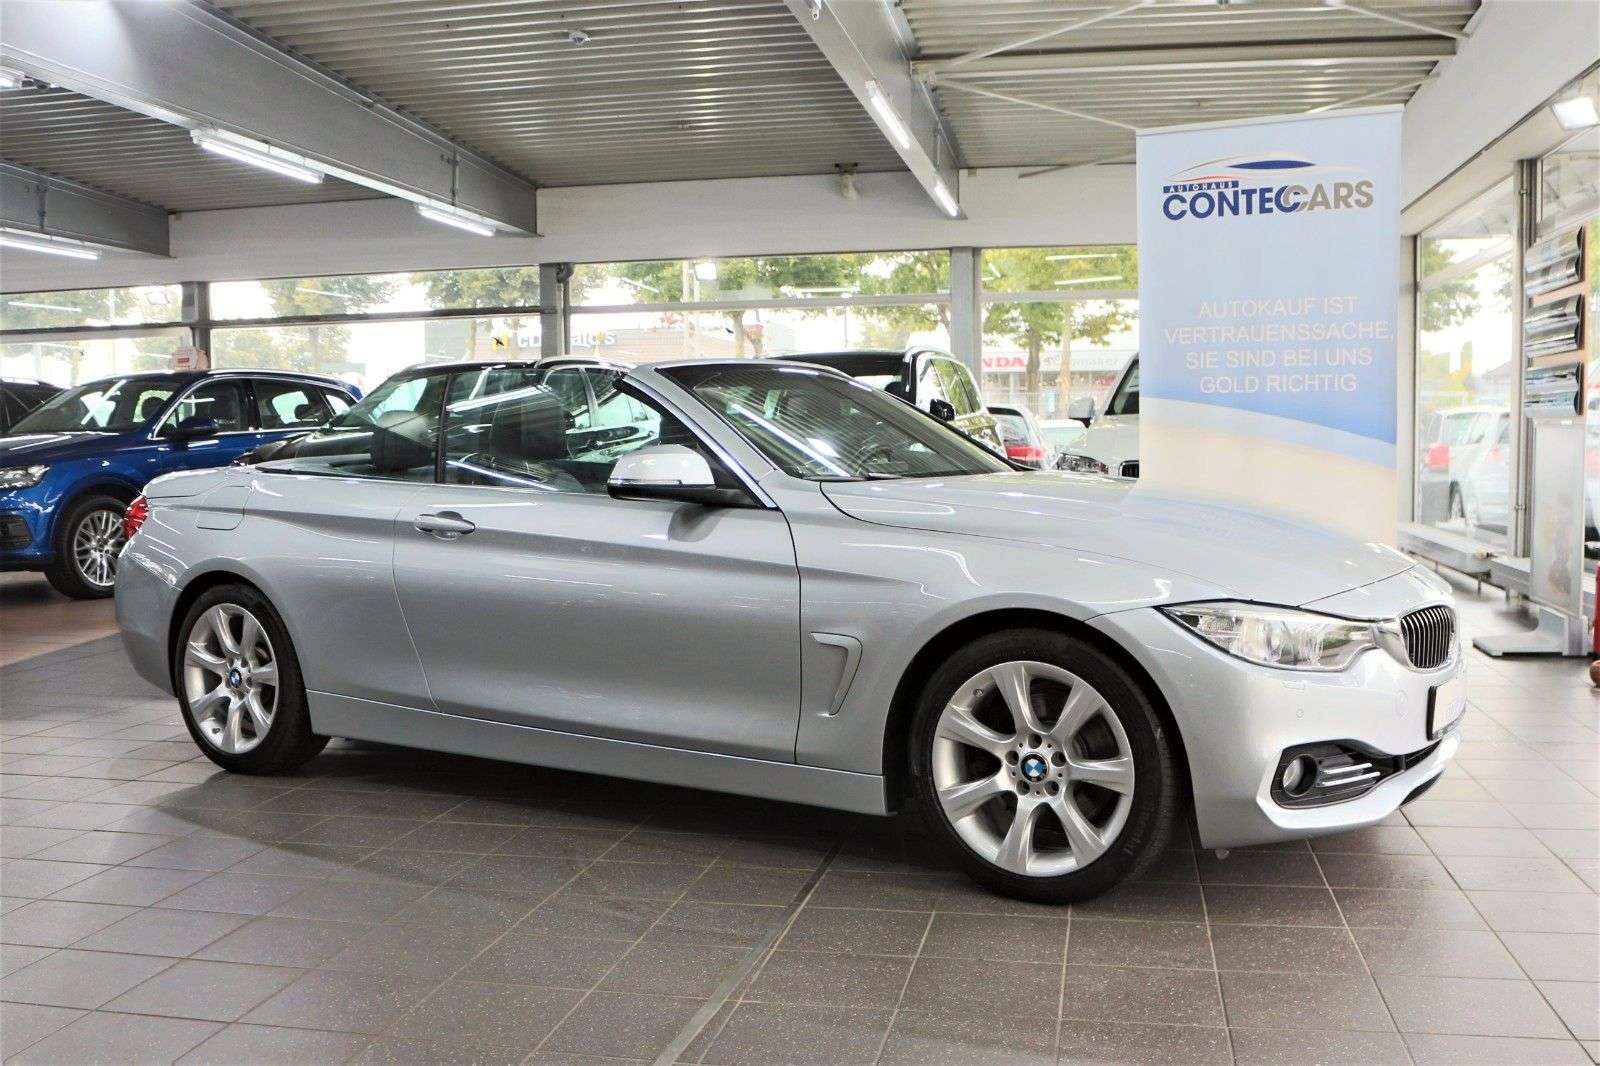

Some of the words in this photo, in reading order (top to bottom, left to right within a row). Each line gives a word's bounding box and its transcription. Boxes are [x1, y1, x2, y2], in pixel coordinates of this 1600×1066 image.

[1169, 181, 1234, 194] AUTOHAUS
[1200, 297, 1316, 319] AUTOKAUF
[1323, 296, 1358, 314] IST
[1164, 321, 1394, 344] VERTRAUENSSACHE,
[1186, 351, 1220, 369] SIE
[1226, 350, 1276, 368] SIND
[1284, 348, 1317, 366] BEI
[1327, 347, 1373, 366] UNS
[1200, 376, 1259, 393] GOLD
[1266, 373, 1357, 392] RICHTIG
